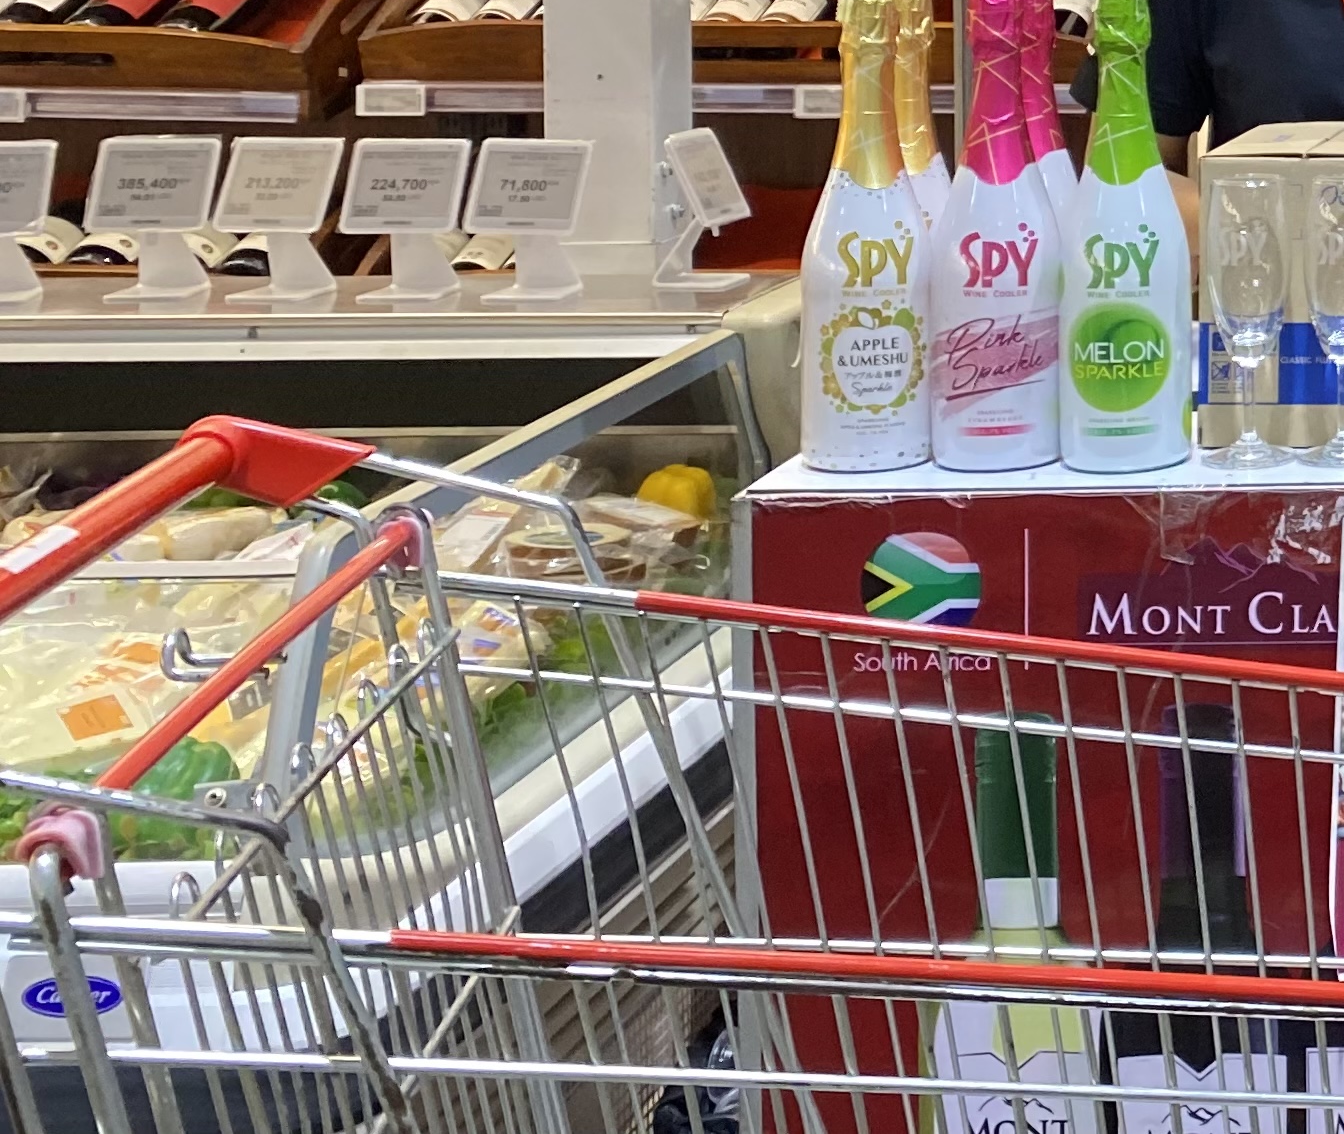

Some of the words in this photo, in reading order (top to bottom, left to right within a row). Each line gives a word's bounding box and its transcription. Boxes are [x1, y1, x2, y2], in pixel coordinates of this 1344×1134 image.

[837, 232, 914, 288] SPY
[959, 232, 1039, 288] SPY
[1084, 233, 1160, 289] SPY
[993, 290, 1028, 298] COOLER
[851, 337, 899, 351] APPLE
[946, 314, 1025, 366] Pink
[1074, 339, 1164, 364] MELON
[952, 339, 1044, 390] Sparkle
[1074, 361, 1164, 380] SPARKLE
[852, 381, 893, 397] Sparkle
[1088, 593, 1230, 635] MONT
[1247, 592, 1337, 634] CLA
[926, 652, 991, 672] Arica
[36, 986, 111, 1004] Caer
